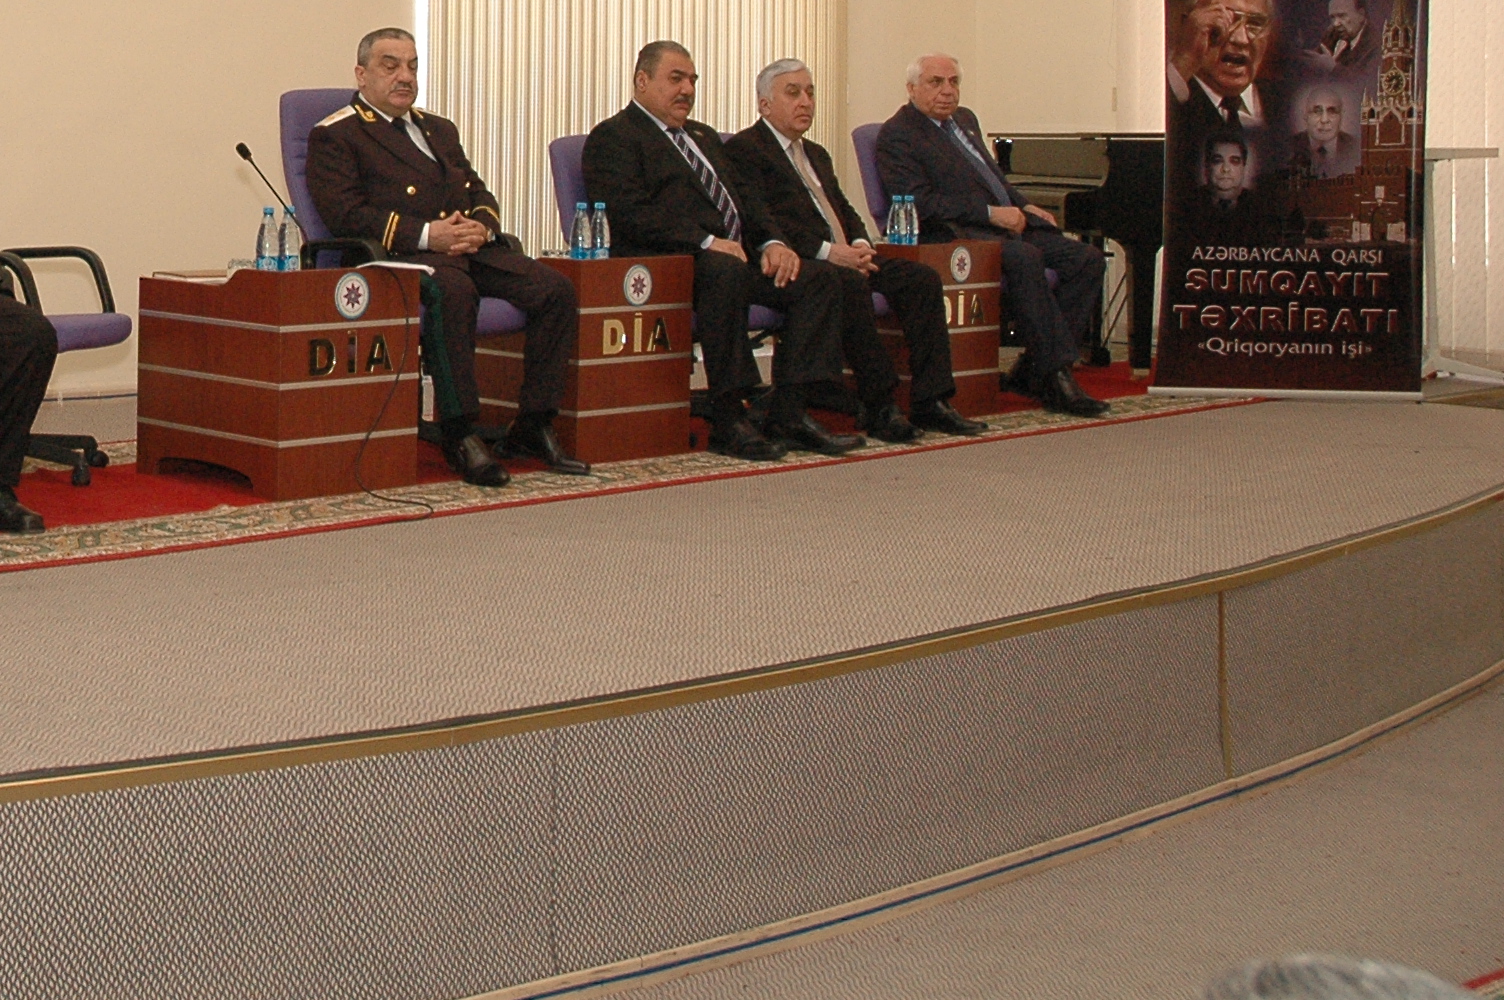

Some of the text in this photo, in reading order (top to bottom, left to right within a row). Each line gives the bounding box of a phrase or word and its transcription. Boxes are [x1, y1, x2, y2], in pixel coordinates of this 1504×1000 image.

[1191, 245, 1384, 267] AZƏRBAYCANA QARŞI
[1184, 267, 1390, 297] SUMQAYIT
[1172, 301, 1399, 333] TƏXRİBATI
[602, 312, 672, 356] DİA
[308, 329, 394, 377] DİA
